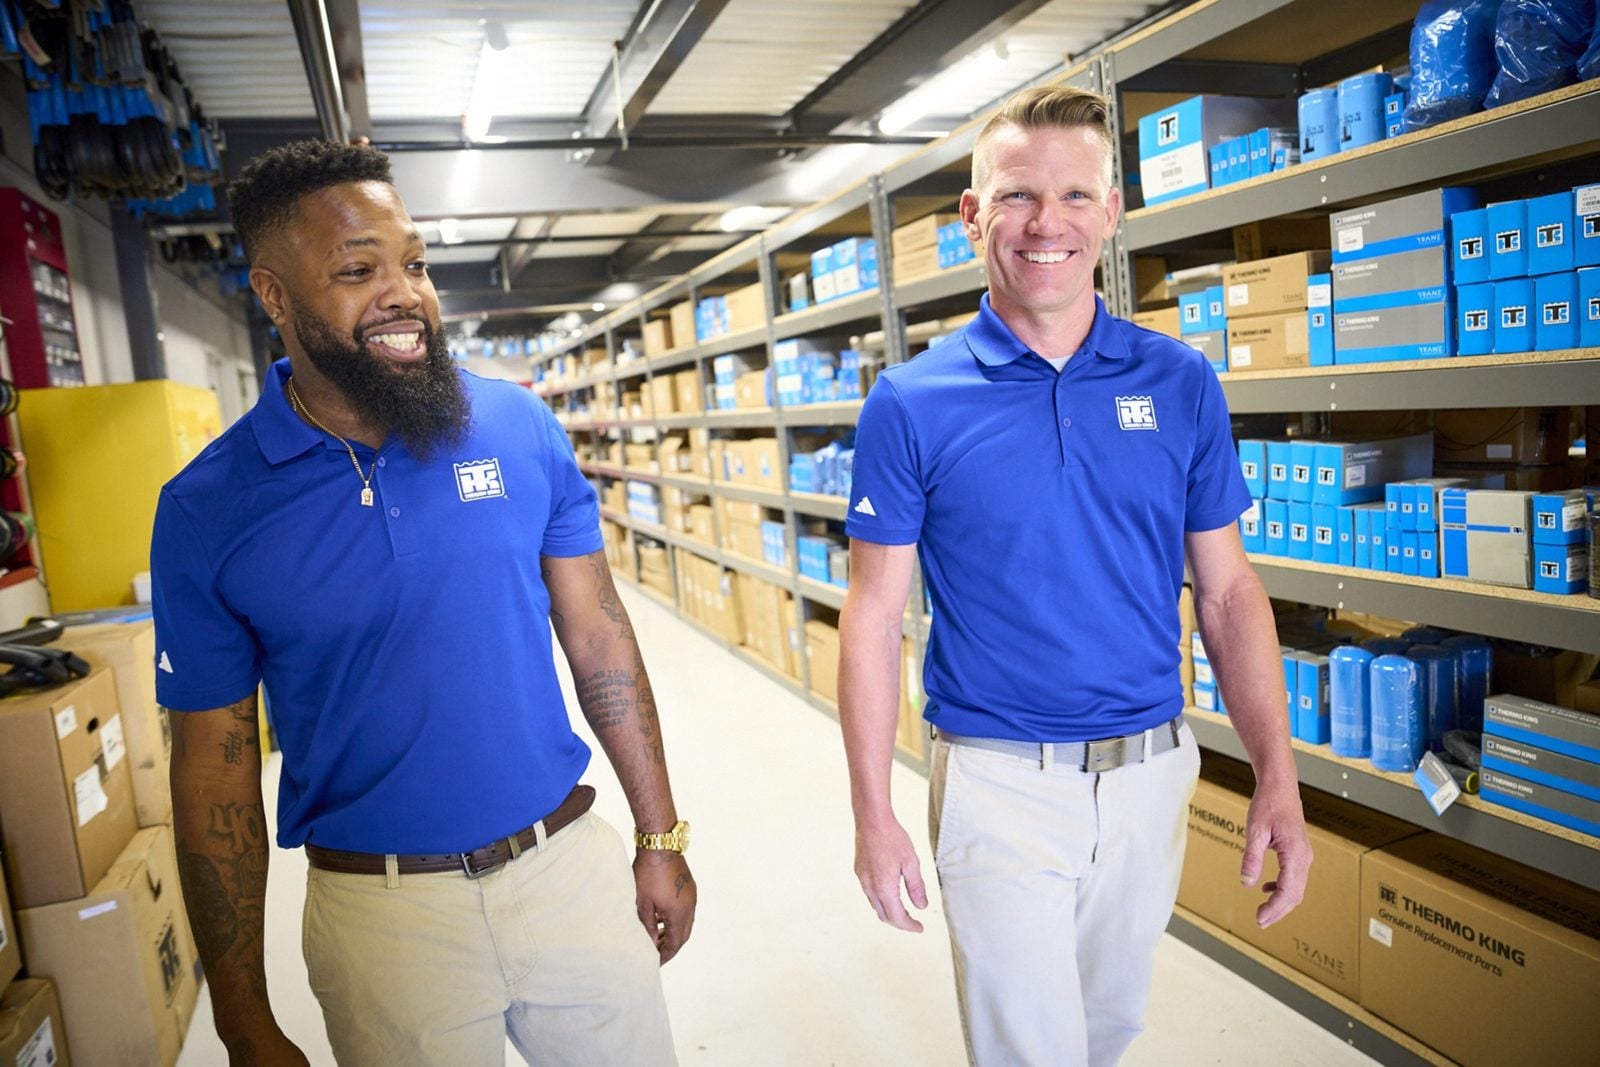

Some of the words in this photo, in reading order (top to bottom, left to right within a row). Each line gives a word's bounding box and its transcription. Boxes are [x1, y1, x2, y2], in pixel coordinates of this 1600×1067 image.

[1498, 708, 1522, 719] THERMO
[1523, 714, 1539, 724] KING
[1495, 743, 1521, 755] THERMO
[1521, 750, 1537, 760] KING
[1492, 776, 1517, 788] THERMO
[1517, 784, 1533, 794] KING
[1188, 803, 1235, 833] THERMO
[1378, 908, 1414, 933] Genuine
[1414, 925, 1474, 962] Replacement
[1475, 955, 1503, 977] Parts
[1402, 896, 1475, 942] THERMO
[1479, 932, 1526, 968] KING
[1292, 937, 1344, 975] TRANE
